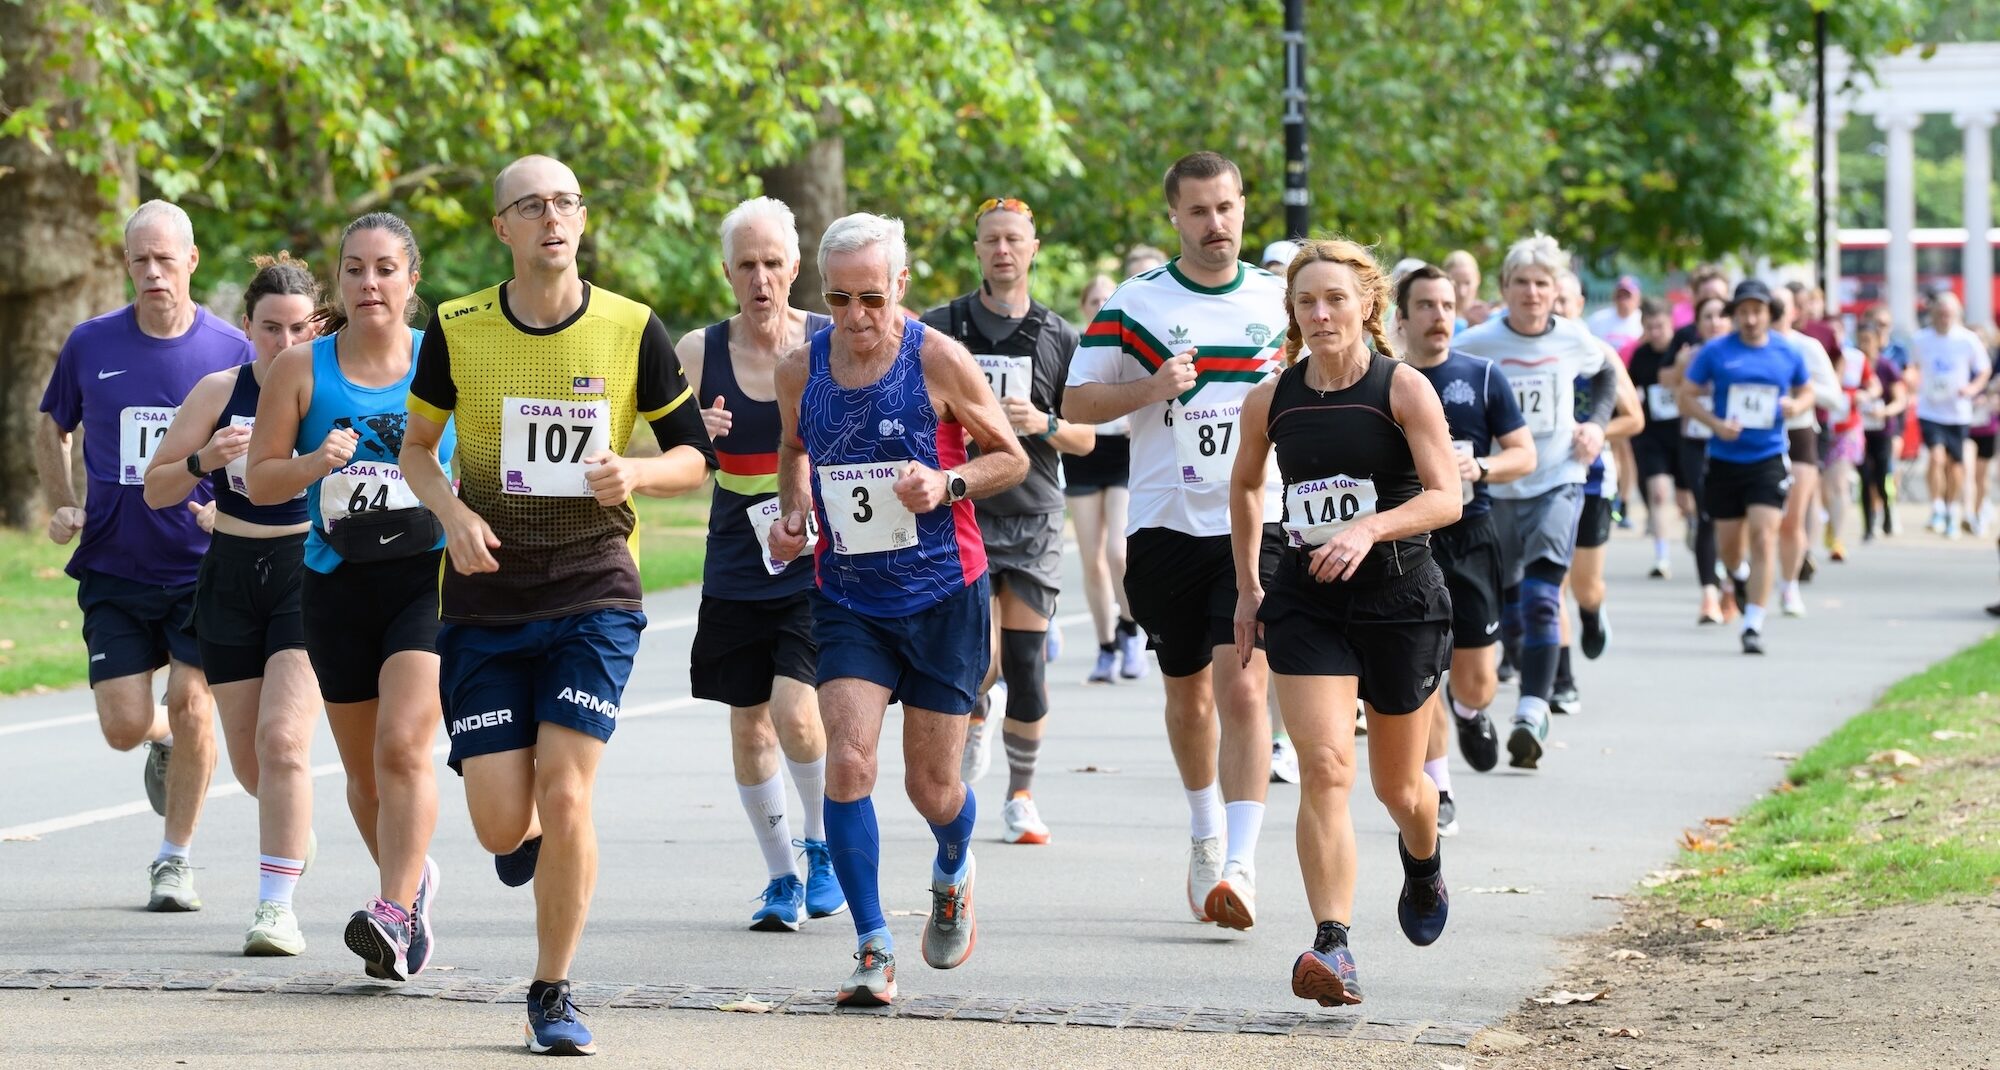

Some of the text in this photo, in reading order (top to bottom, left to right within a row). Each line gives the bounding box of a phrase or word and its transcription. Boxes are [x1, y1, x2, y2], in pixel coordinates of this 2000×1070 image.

[444, 302, 493, 320] LINE 7
[976, 360, 1000, 368] SAA
[134, 412, 168, 421] CSAA
[520, 404, 597, 419] CSAA 10K
[1184, 406, 1242, 421] CSAA 10K
[527, 422, 594, 463] 107
[1198, 422, 1233, 457] 87
[340, 466, 377, 477] CSAA
[830, 468, 895, 481] CSAA 10K
[1297, 479, 1359, 495] CSAA 10K
[348, 482, 389, 513] 64
[851, 486, 873, 523] 3
[762, 503, 779, 516] CS
[1303, 493, 1359, 525] 140
